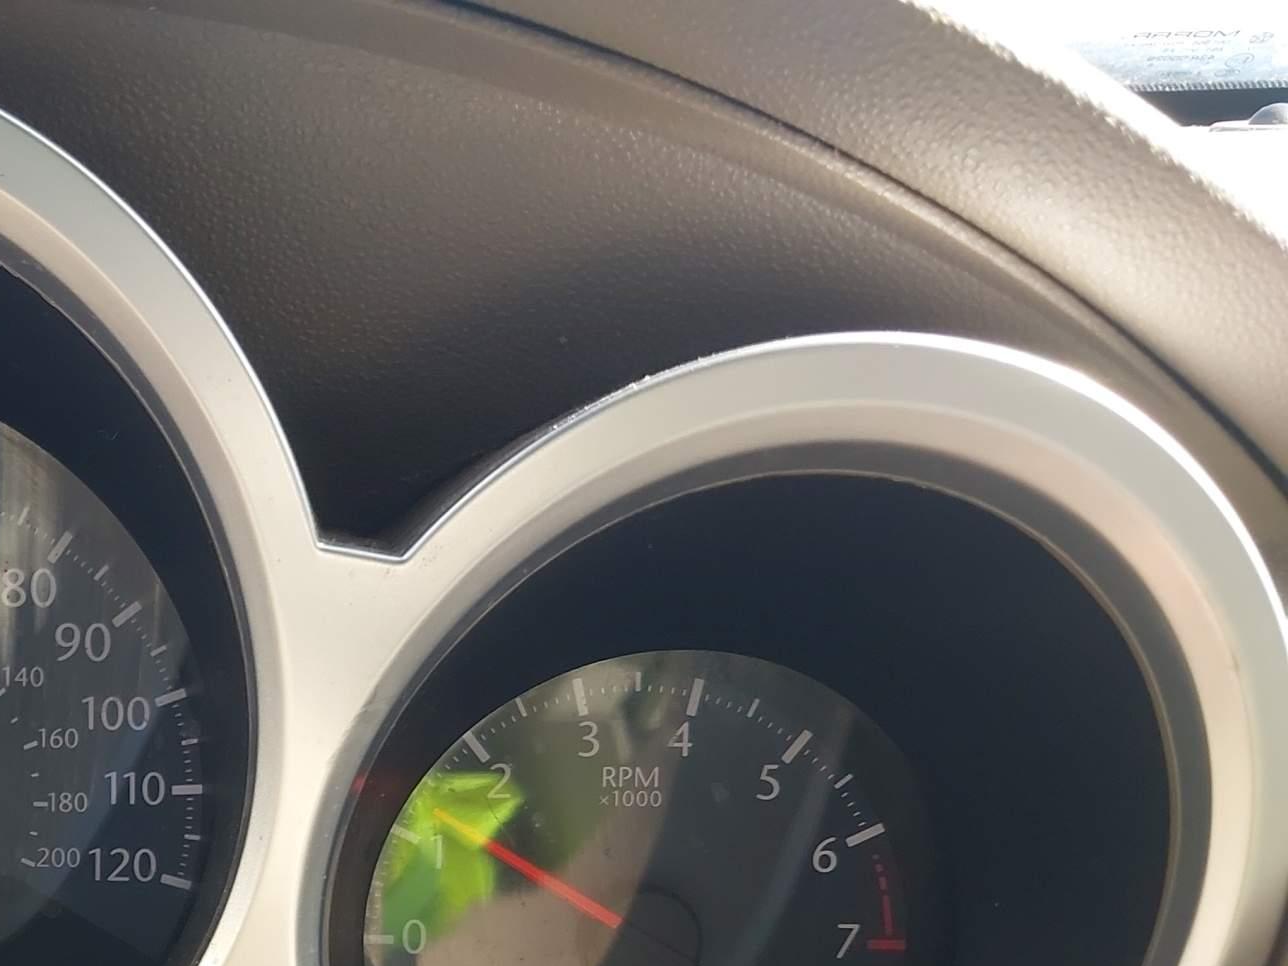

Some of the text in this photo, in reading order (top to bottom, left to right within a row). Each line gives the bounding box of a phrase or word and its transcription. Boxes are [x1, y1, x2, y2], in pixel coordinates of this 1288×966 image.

[1, 568, 57, 608] 80
[54, 622, 112, 662] 90
[3, 666, 44, 688] 140
[81, 696, 151, 731] 100
[38, 728, 79, 749] 160
[578, 722, 600, 758] 3
[667, 722, 693, 757] 4
[104, 771, 165, 806] 110
[486, 763, 512, 799] 2
[601, 766, 660, 788] RPM
[756, 765, 781, 800] 5
[48, 793, 88, 813] 180
[37, 848, 81, 868] 200
[88, 848, 157, 883] 120
[429, 835, 444, 870] 1
[813, 837, 837, 873] 6
[402, 919, 427, 954] 0
[837, 923, 861, 958] 7
